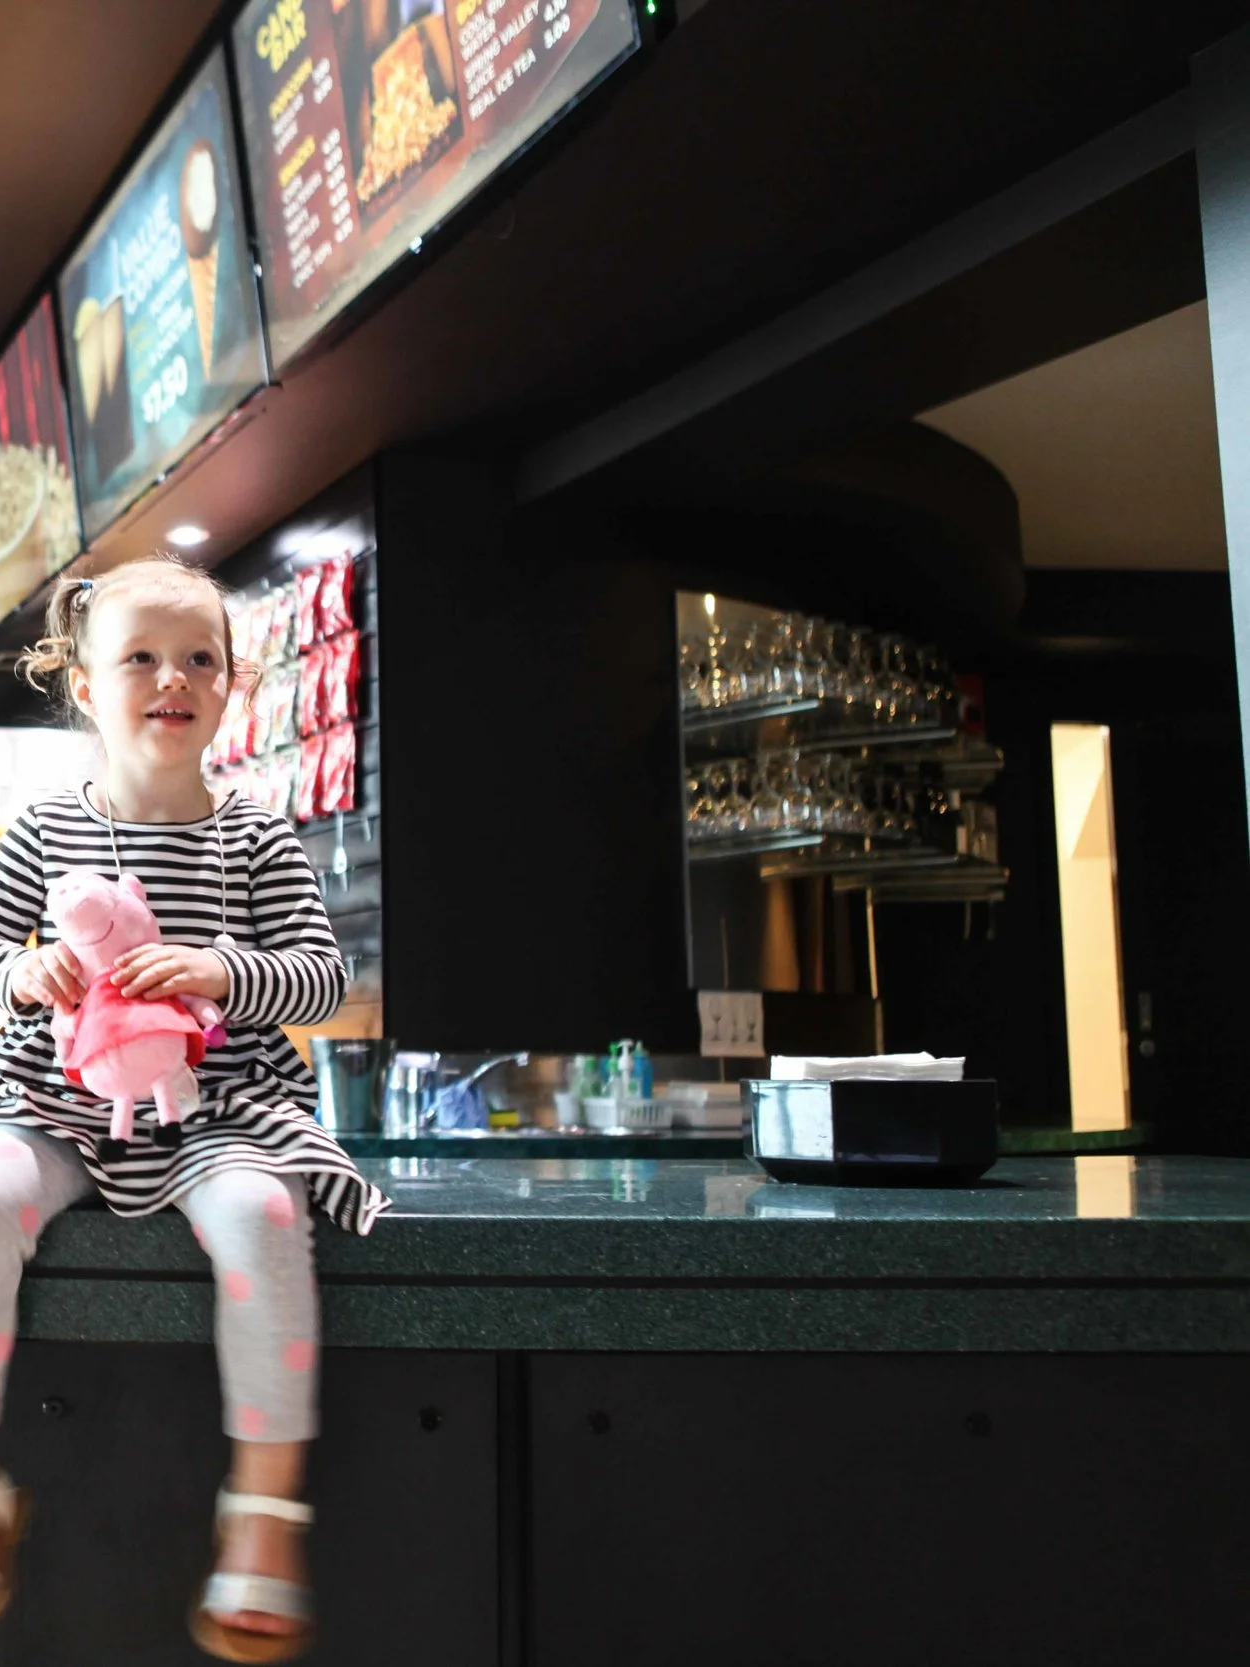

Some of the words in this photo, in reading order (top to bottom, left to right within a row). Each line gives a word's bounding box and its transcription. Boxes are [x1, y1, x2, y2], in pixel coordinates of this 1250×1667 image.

[499, 0, 539, 46] VALLEY
[494, 67, 515, 96] ICE
[513, 47, 537, 78] TEA
